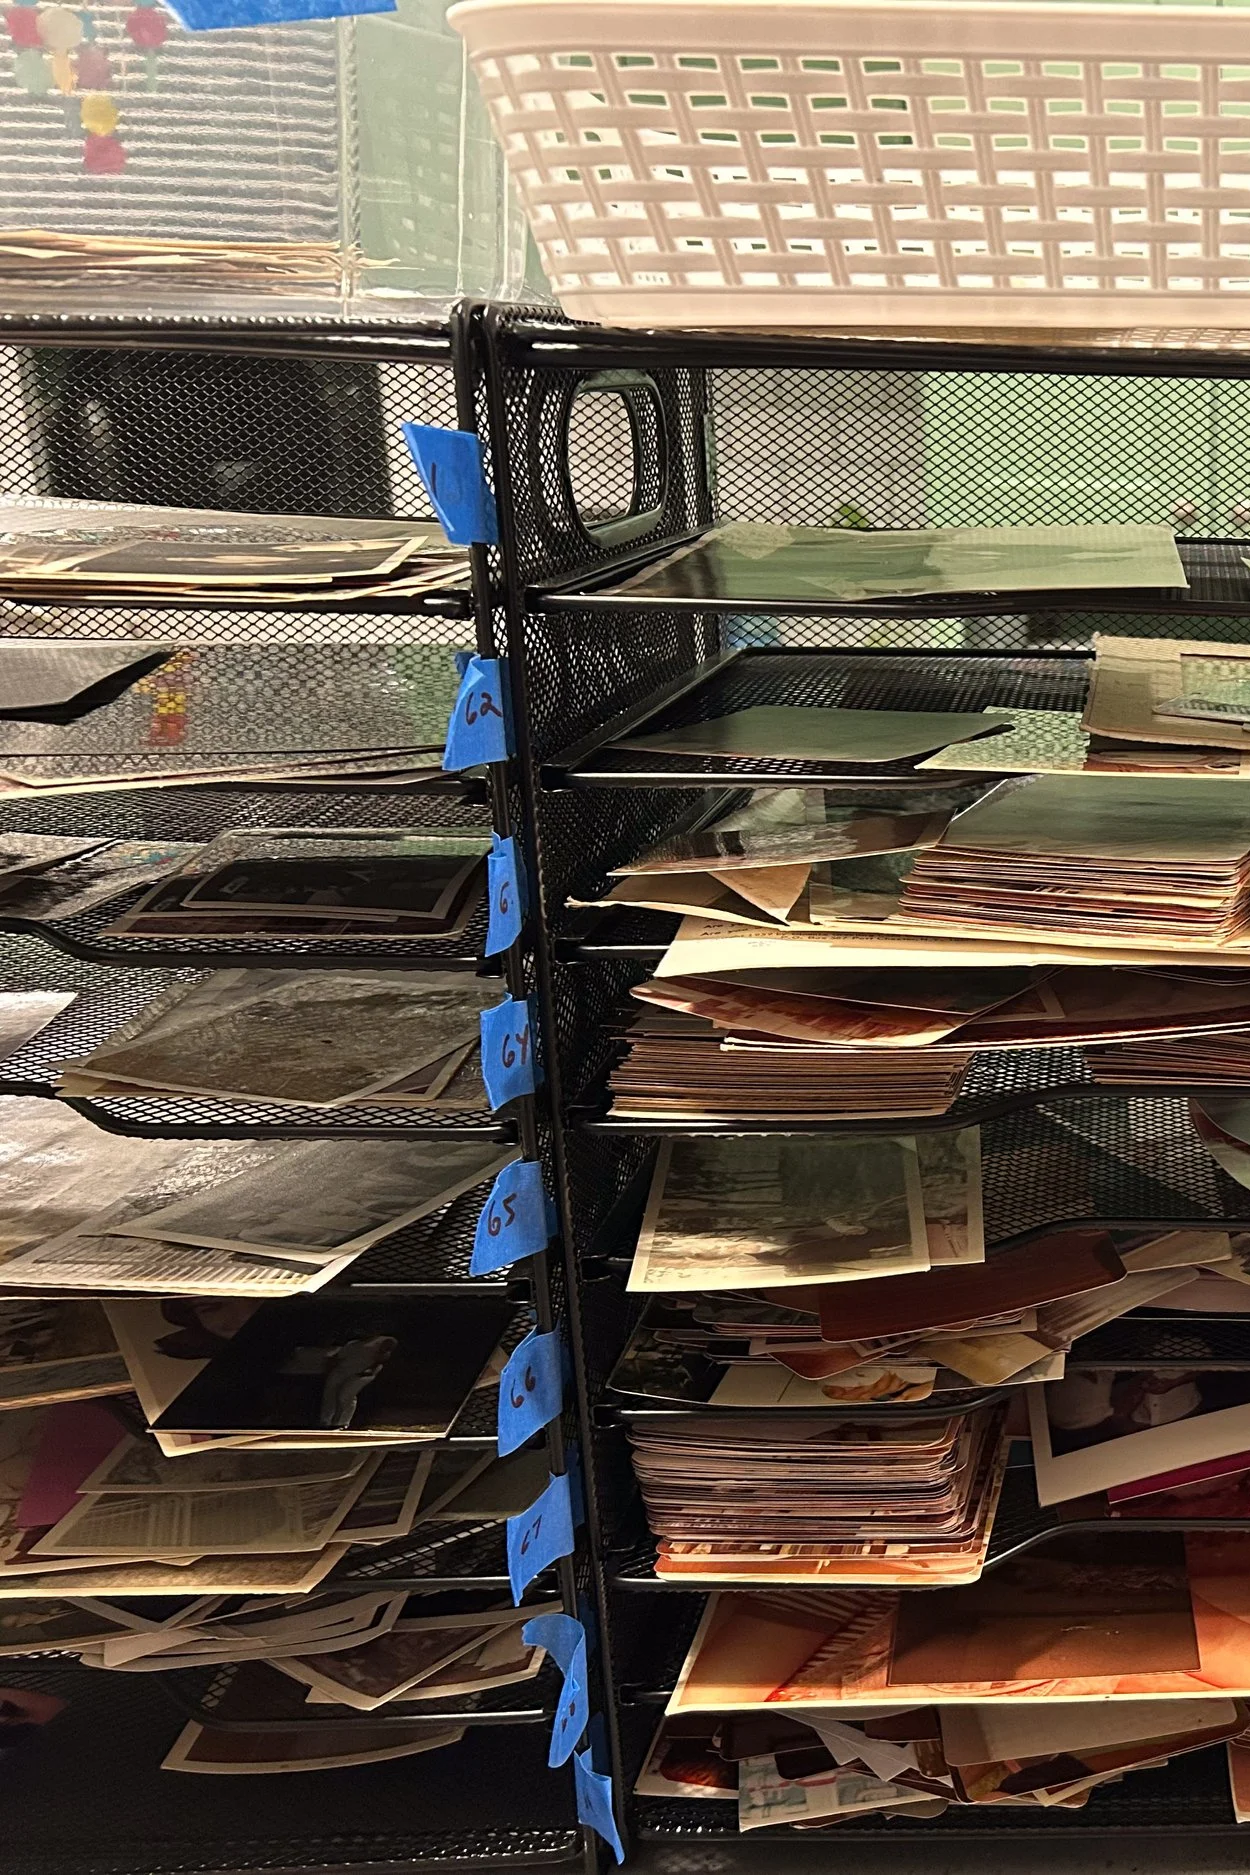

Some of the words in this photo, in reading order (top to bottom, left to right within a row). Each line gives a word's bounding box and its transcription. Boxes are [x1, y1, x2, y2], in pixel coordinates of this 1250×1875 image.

[465, 691, 503, 726] 62
[501, 1023, 530, 1069] 64
[487, 1192, 518, 1238] 65
[510, 1364, 536, 1409] 66
